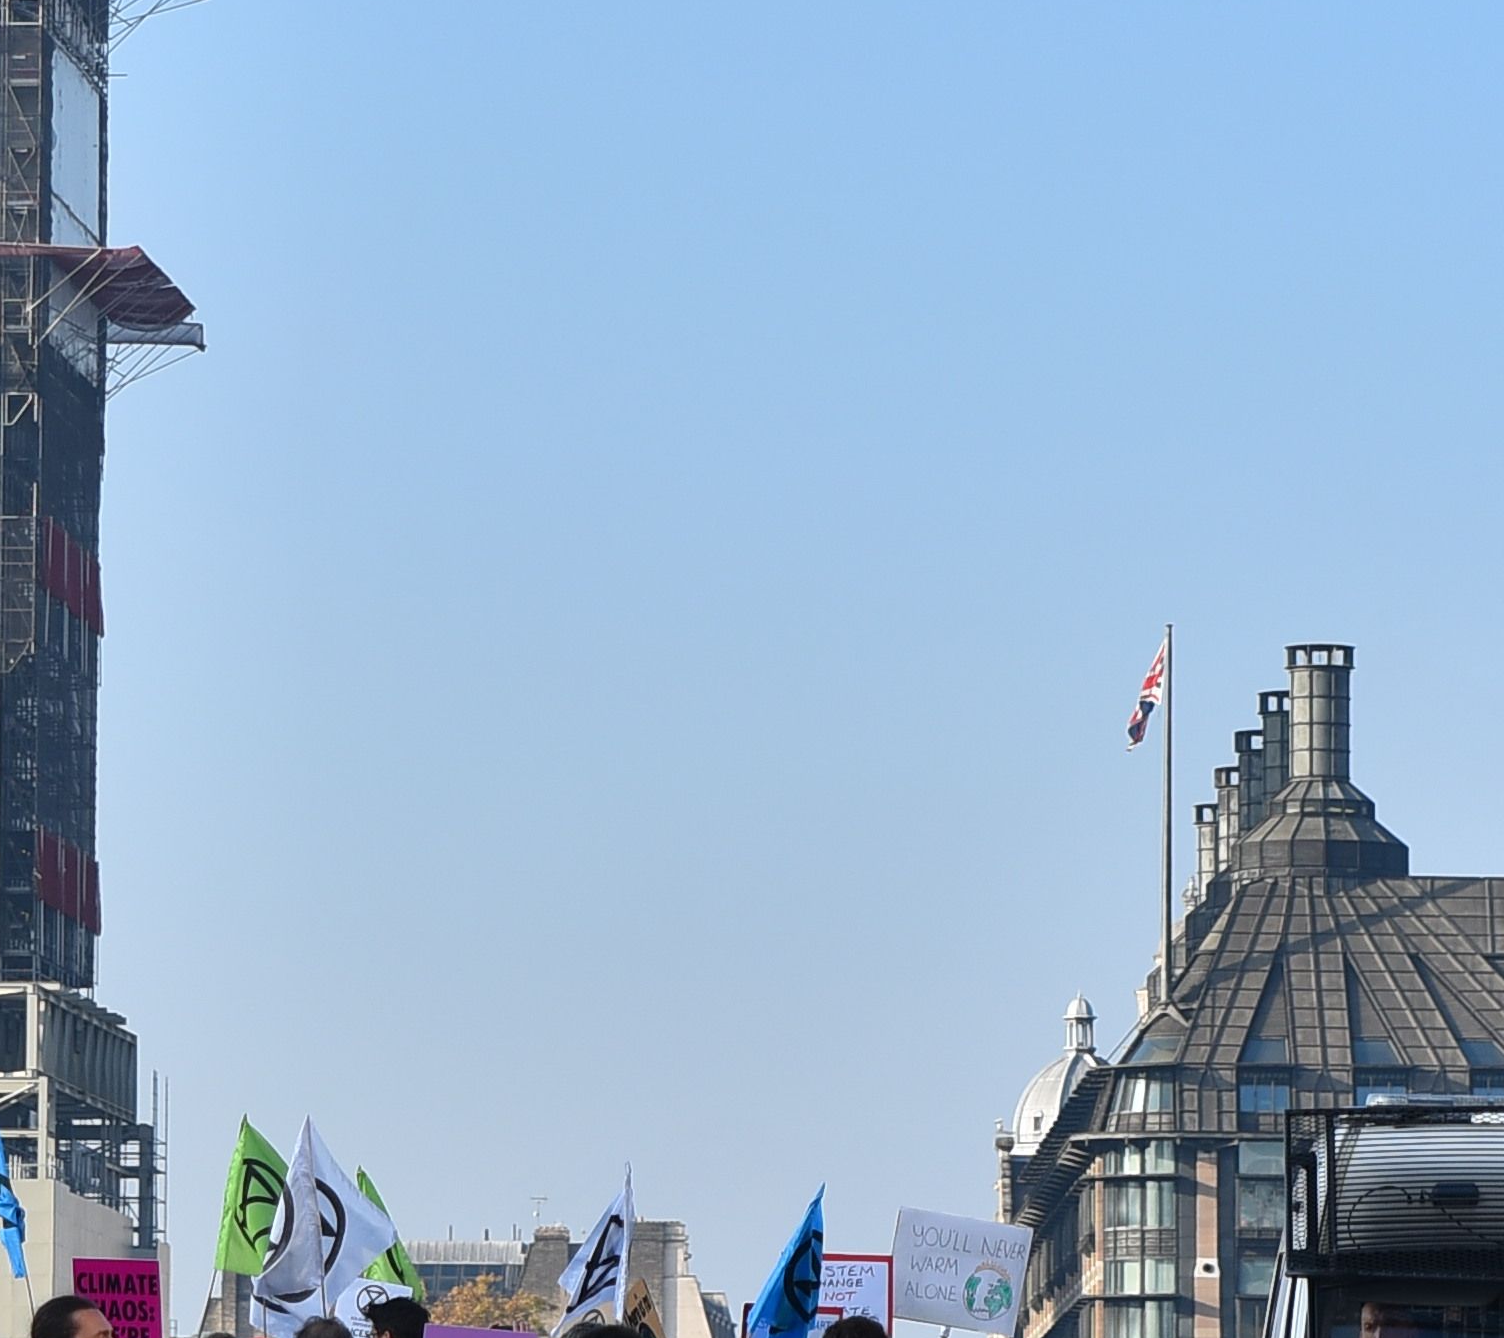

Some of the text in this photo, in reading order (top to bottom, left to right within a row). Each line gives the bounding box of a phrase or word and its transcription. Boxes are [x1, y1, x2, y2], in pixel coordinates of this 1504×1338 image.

[912, 1224, 1026, 1260] YOU'LL NEVER
[824, 1265, 875, 1277] STEM
[910, 1255, 959, 1276] WARM
[76, 1272, 158, 1296] CLIMATE
[905, 1281, 958, 1302] ALONE
[824, 1291, 857, 1302] NOT
